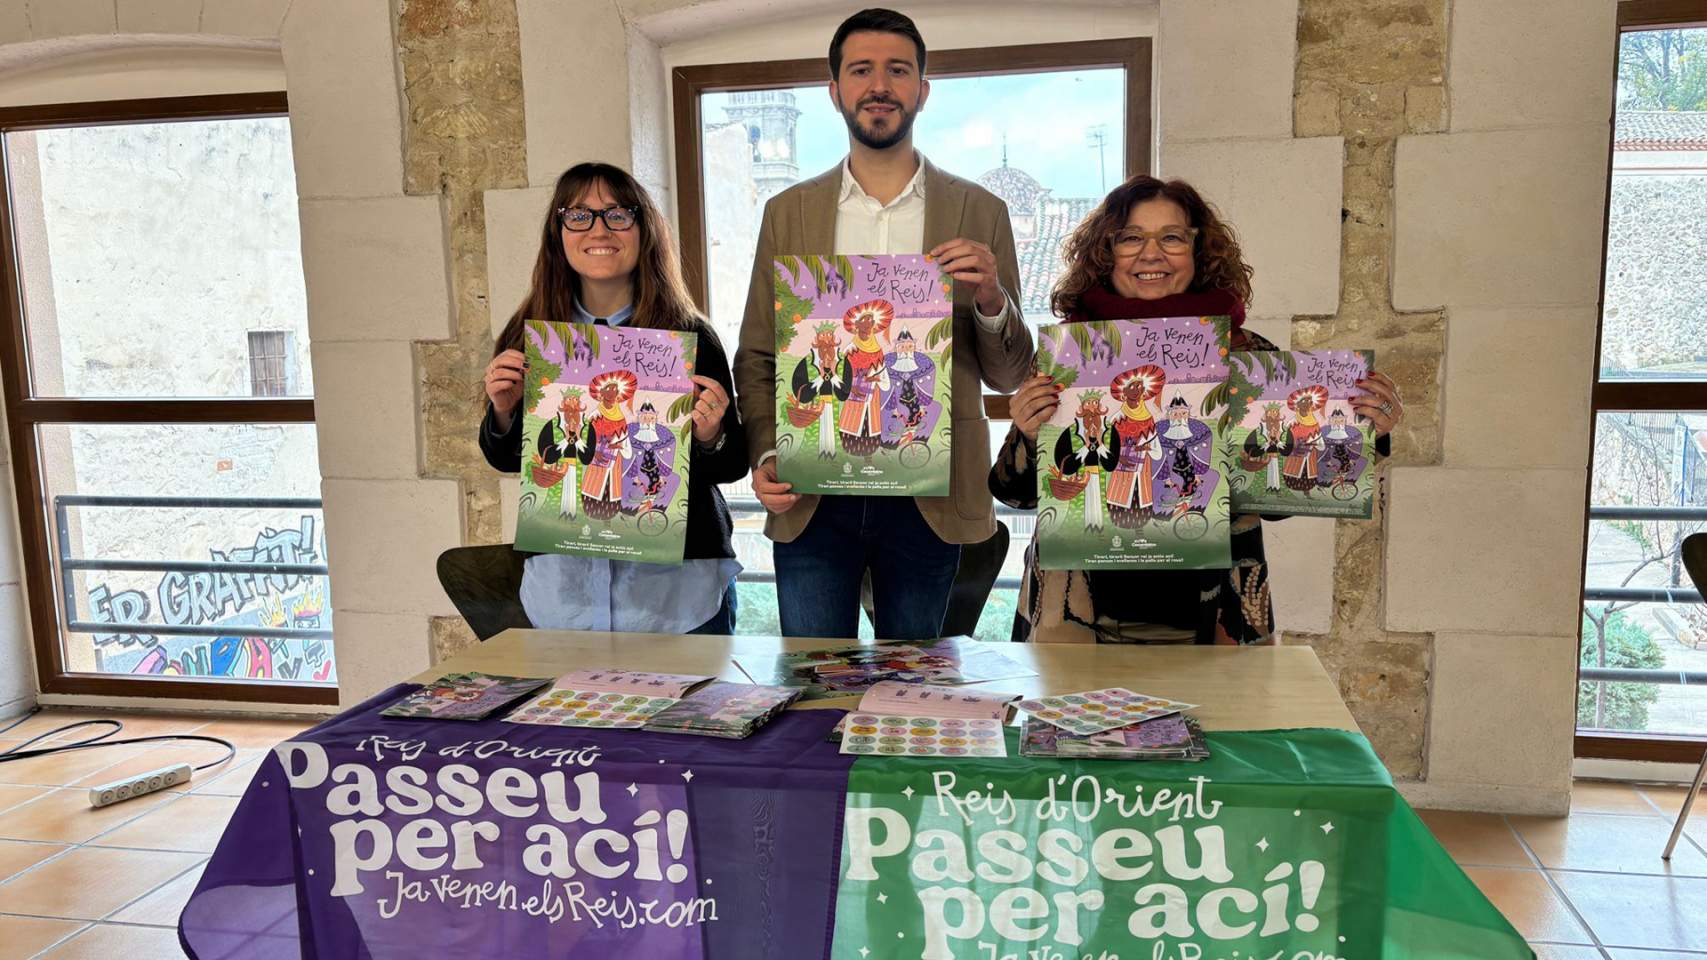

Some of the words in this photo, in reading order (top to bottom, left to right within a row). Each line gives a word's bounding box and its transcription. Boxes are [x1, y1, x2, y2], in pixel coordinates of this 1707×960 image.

[867, 279, 887, 297] els
[890, 279, 934, 304] Reis!
[612, 350, 632, 368] els
[634, 352, 678, 378] Reis!
[1136, 344, 1158, 363] els
[1161, 343, 1209, 369] Reis!
[932, 771, 1017, 827] Reis
[1035, 775, 1224, 823] d'Orient
[328, 817, 501, 897] per
[521, 808, 690, 883] ací!
[845, 807, 1234, 886] Passeu
[917, 884, 1106, 960] per
[1127, 860, 1326, 942] ací!
